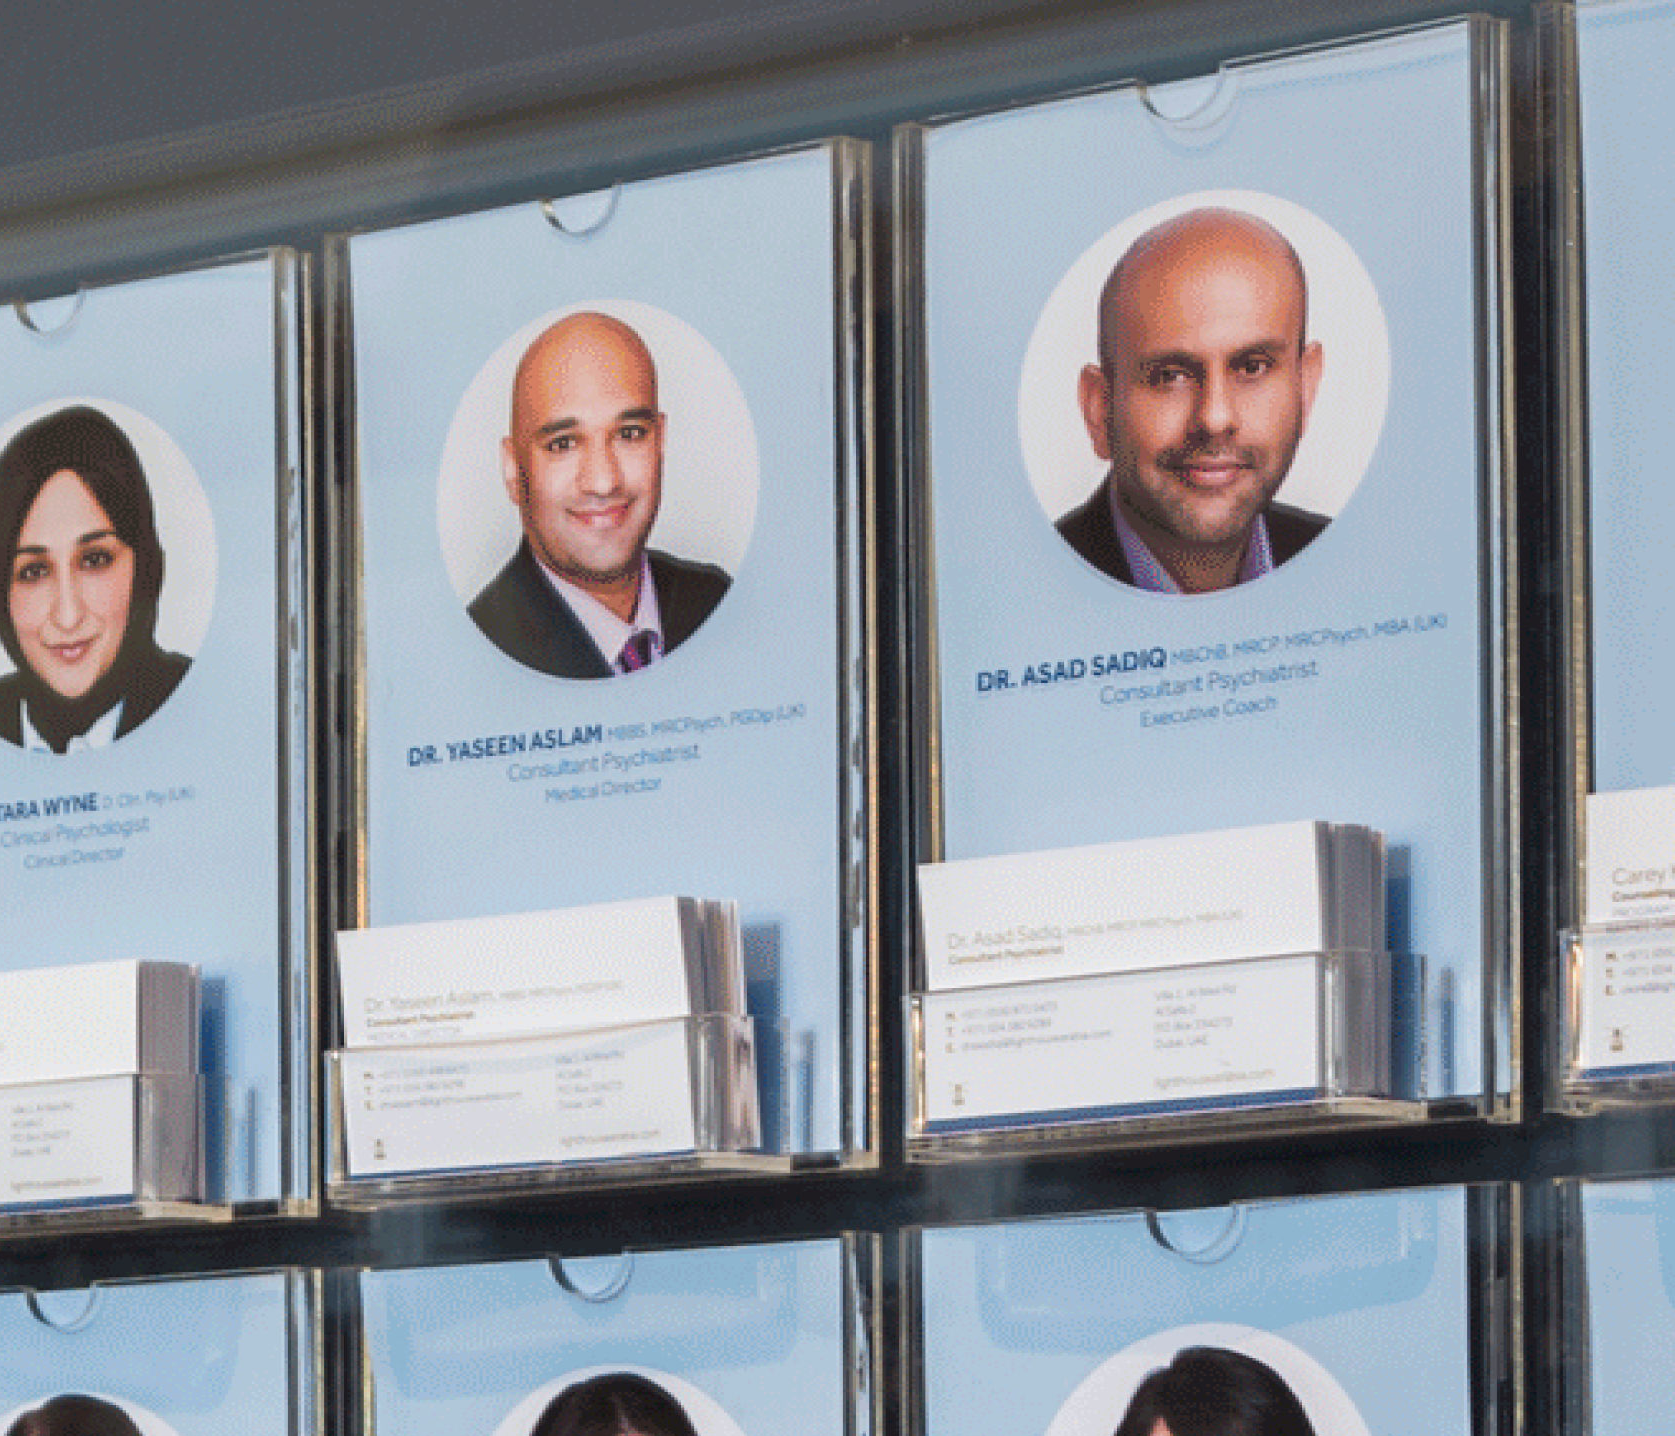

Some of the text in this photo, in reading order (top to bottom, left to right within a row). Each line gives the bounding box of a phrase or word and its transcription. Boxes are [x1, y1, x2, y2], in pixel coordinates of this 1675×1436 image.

[976, 669, 1017, 692] DR.
[1021, 657, 1087, 686] ASAD
[1091, 646, 1167, 677] SADIQ
[1099, 660, 1318, 706] Consultant Psychiatrist
[1140, 695, 1277, 728] Executive Coach
[407, 745, 443, 767] DR.
[446, 734, 526, 762] YASEEN
[528, 723, 603, 751] ASLAM
[507, 744, 701, 781] Consultant Psychiatrist
[42, 791, 99, 817] WYNE
[545, 777, 661, 802] Medical Director
[0, 816, 150, 848] Clinical Psychologist
[1611, 866, 1668, 888] Carey
